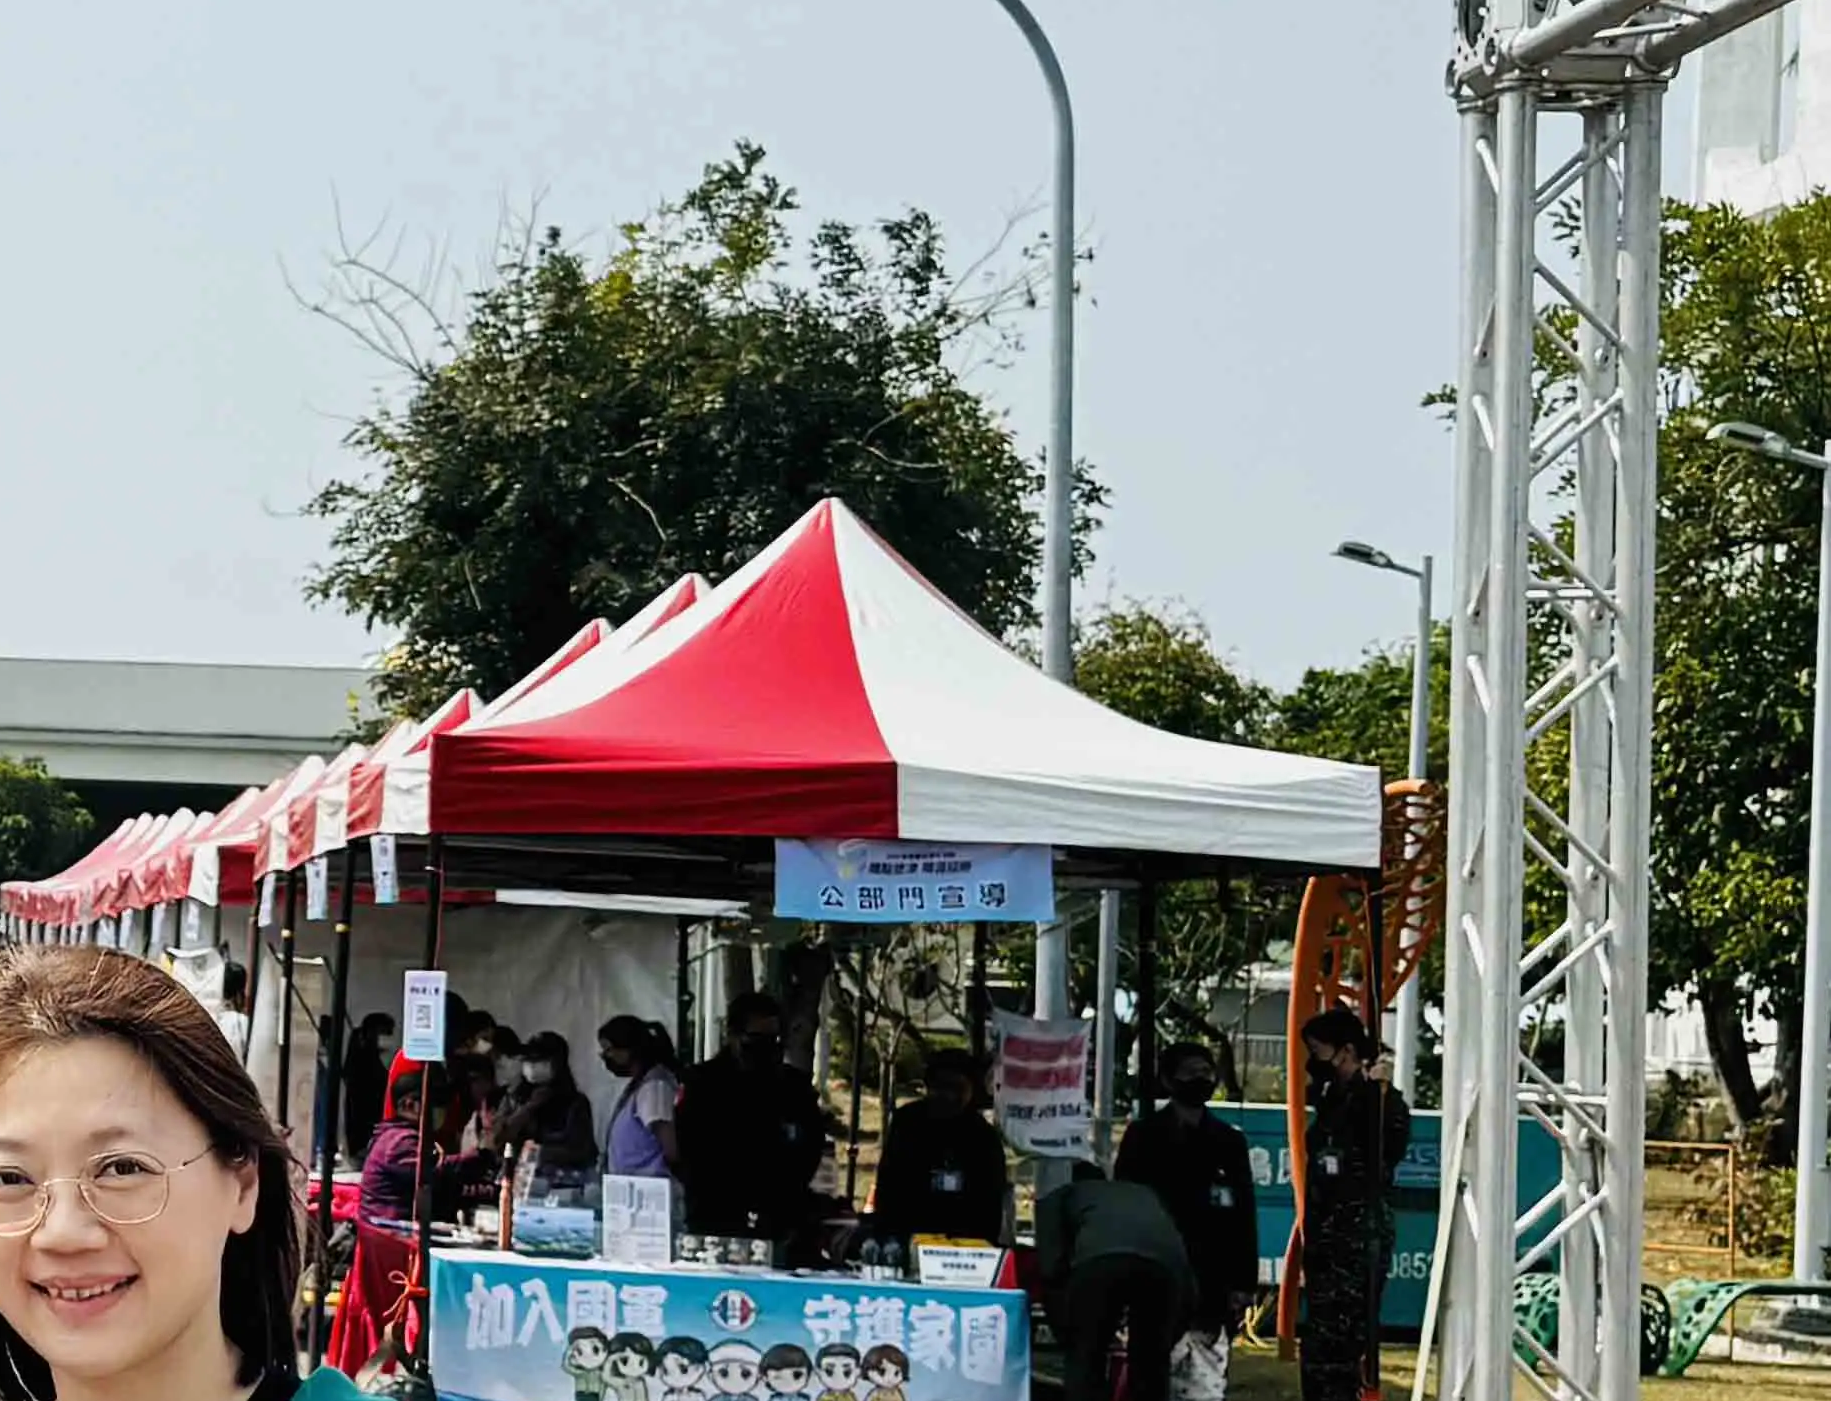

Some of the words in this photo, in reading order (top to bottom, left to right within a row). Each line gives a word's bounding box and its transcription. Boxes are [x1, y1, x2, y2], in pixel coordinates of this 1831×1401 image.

[820, 882, 1006, 910] 公部門宣導
[465, 1272, 669, 1351] 加入國軍
[803, 1293, 1007, 1385] 守護家園
